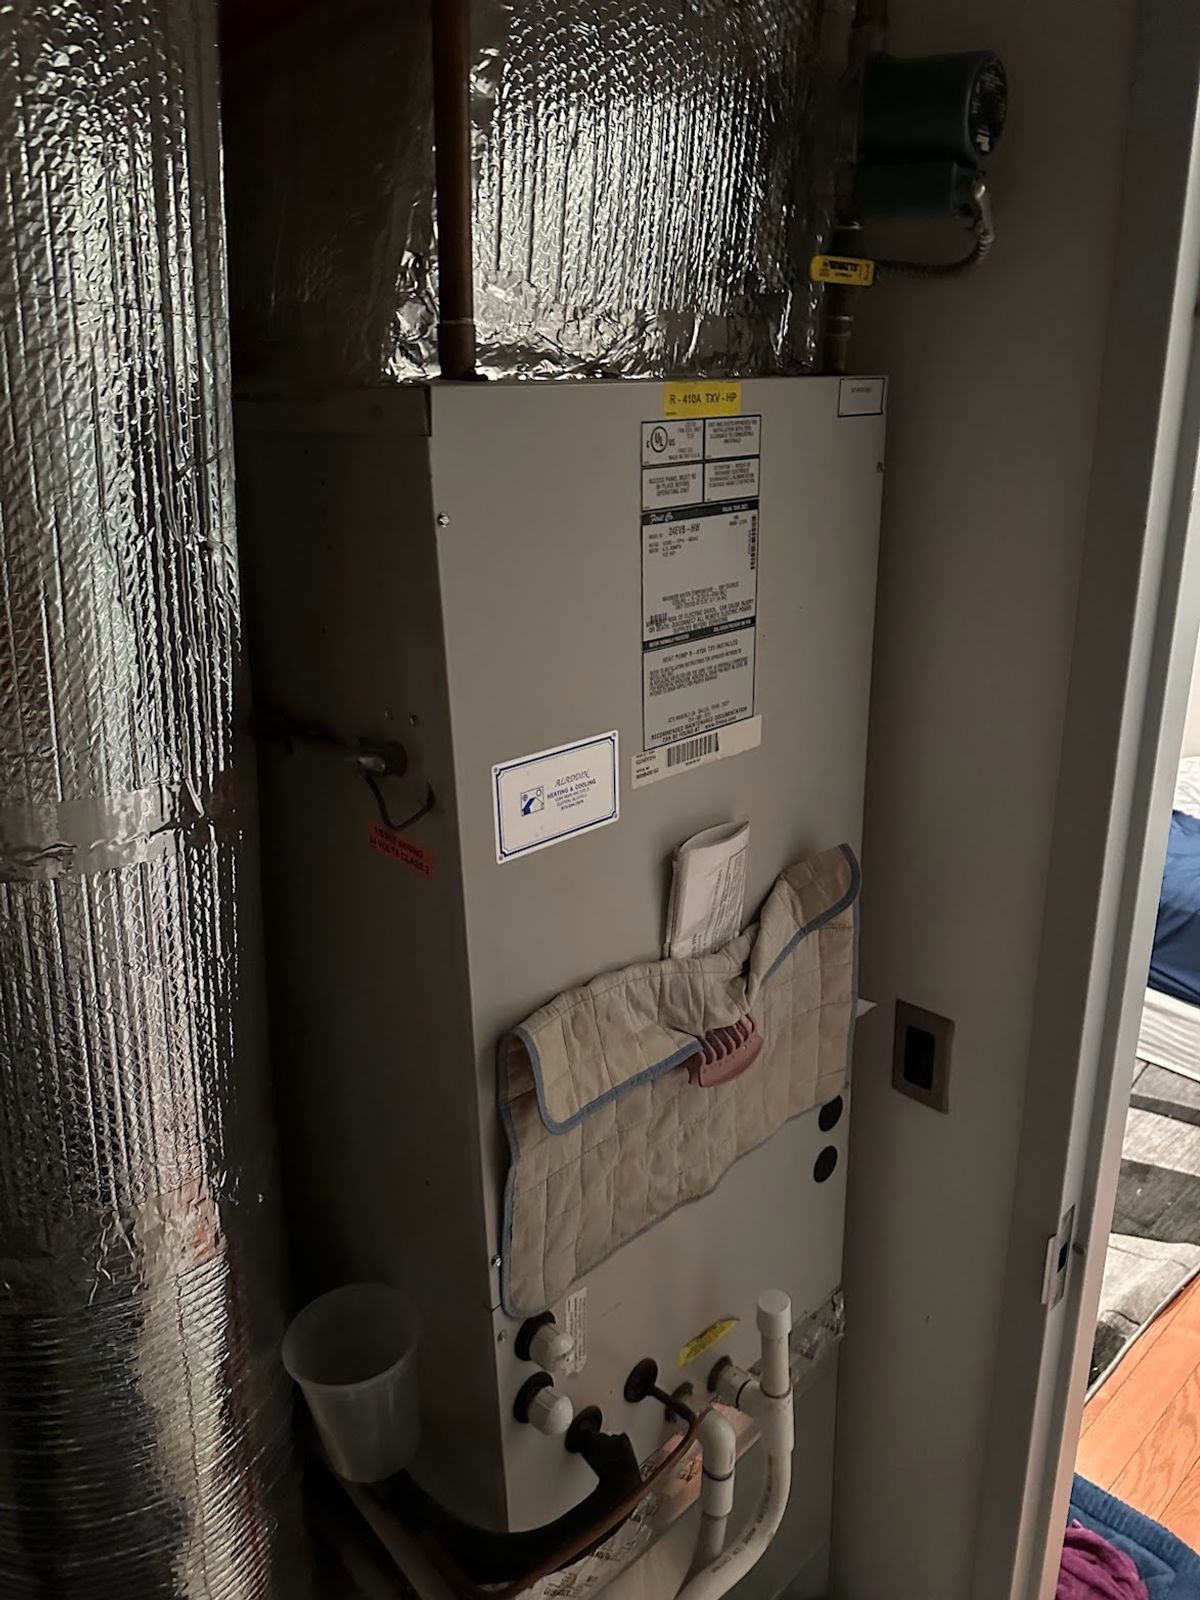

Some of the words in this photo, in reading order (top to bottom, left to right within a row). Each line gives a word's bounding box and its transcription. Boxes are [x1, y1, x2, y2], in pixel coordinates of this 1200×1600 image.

[651, 726, 684, 740] RECOMMENDED
[685, 716, 714, 730] MAINTENANCE
[547, 788, 568, 800] HEATING
[575, 778, 596, 790] COOLING
